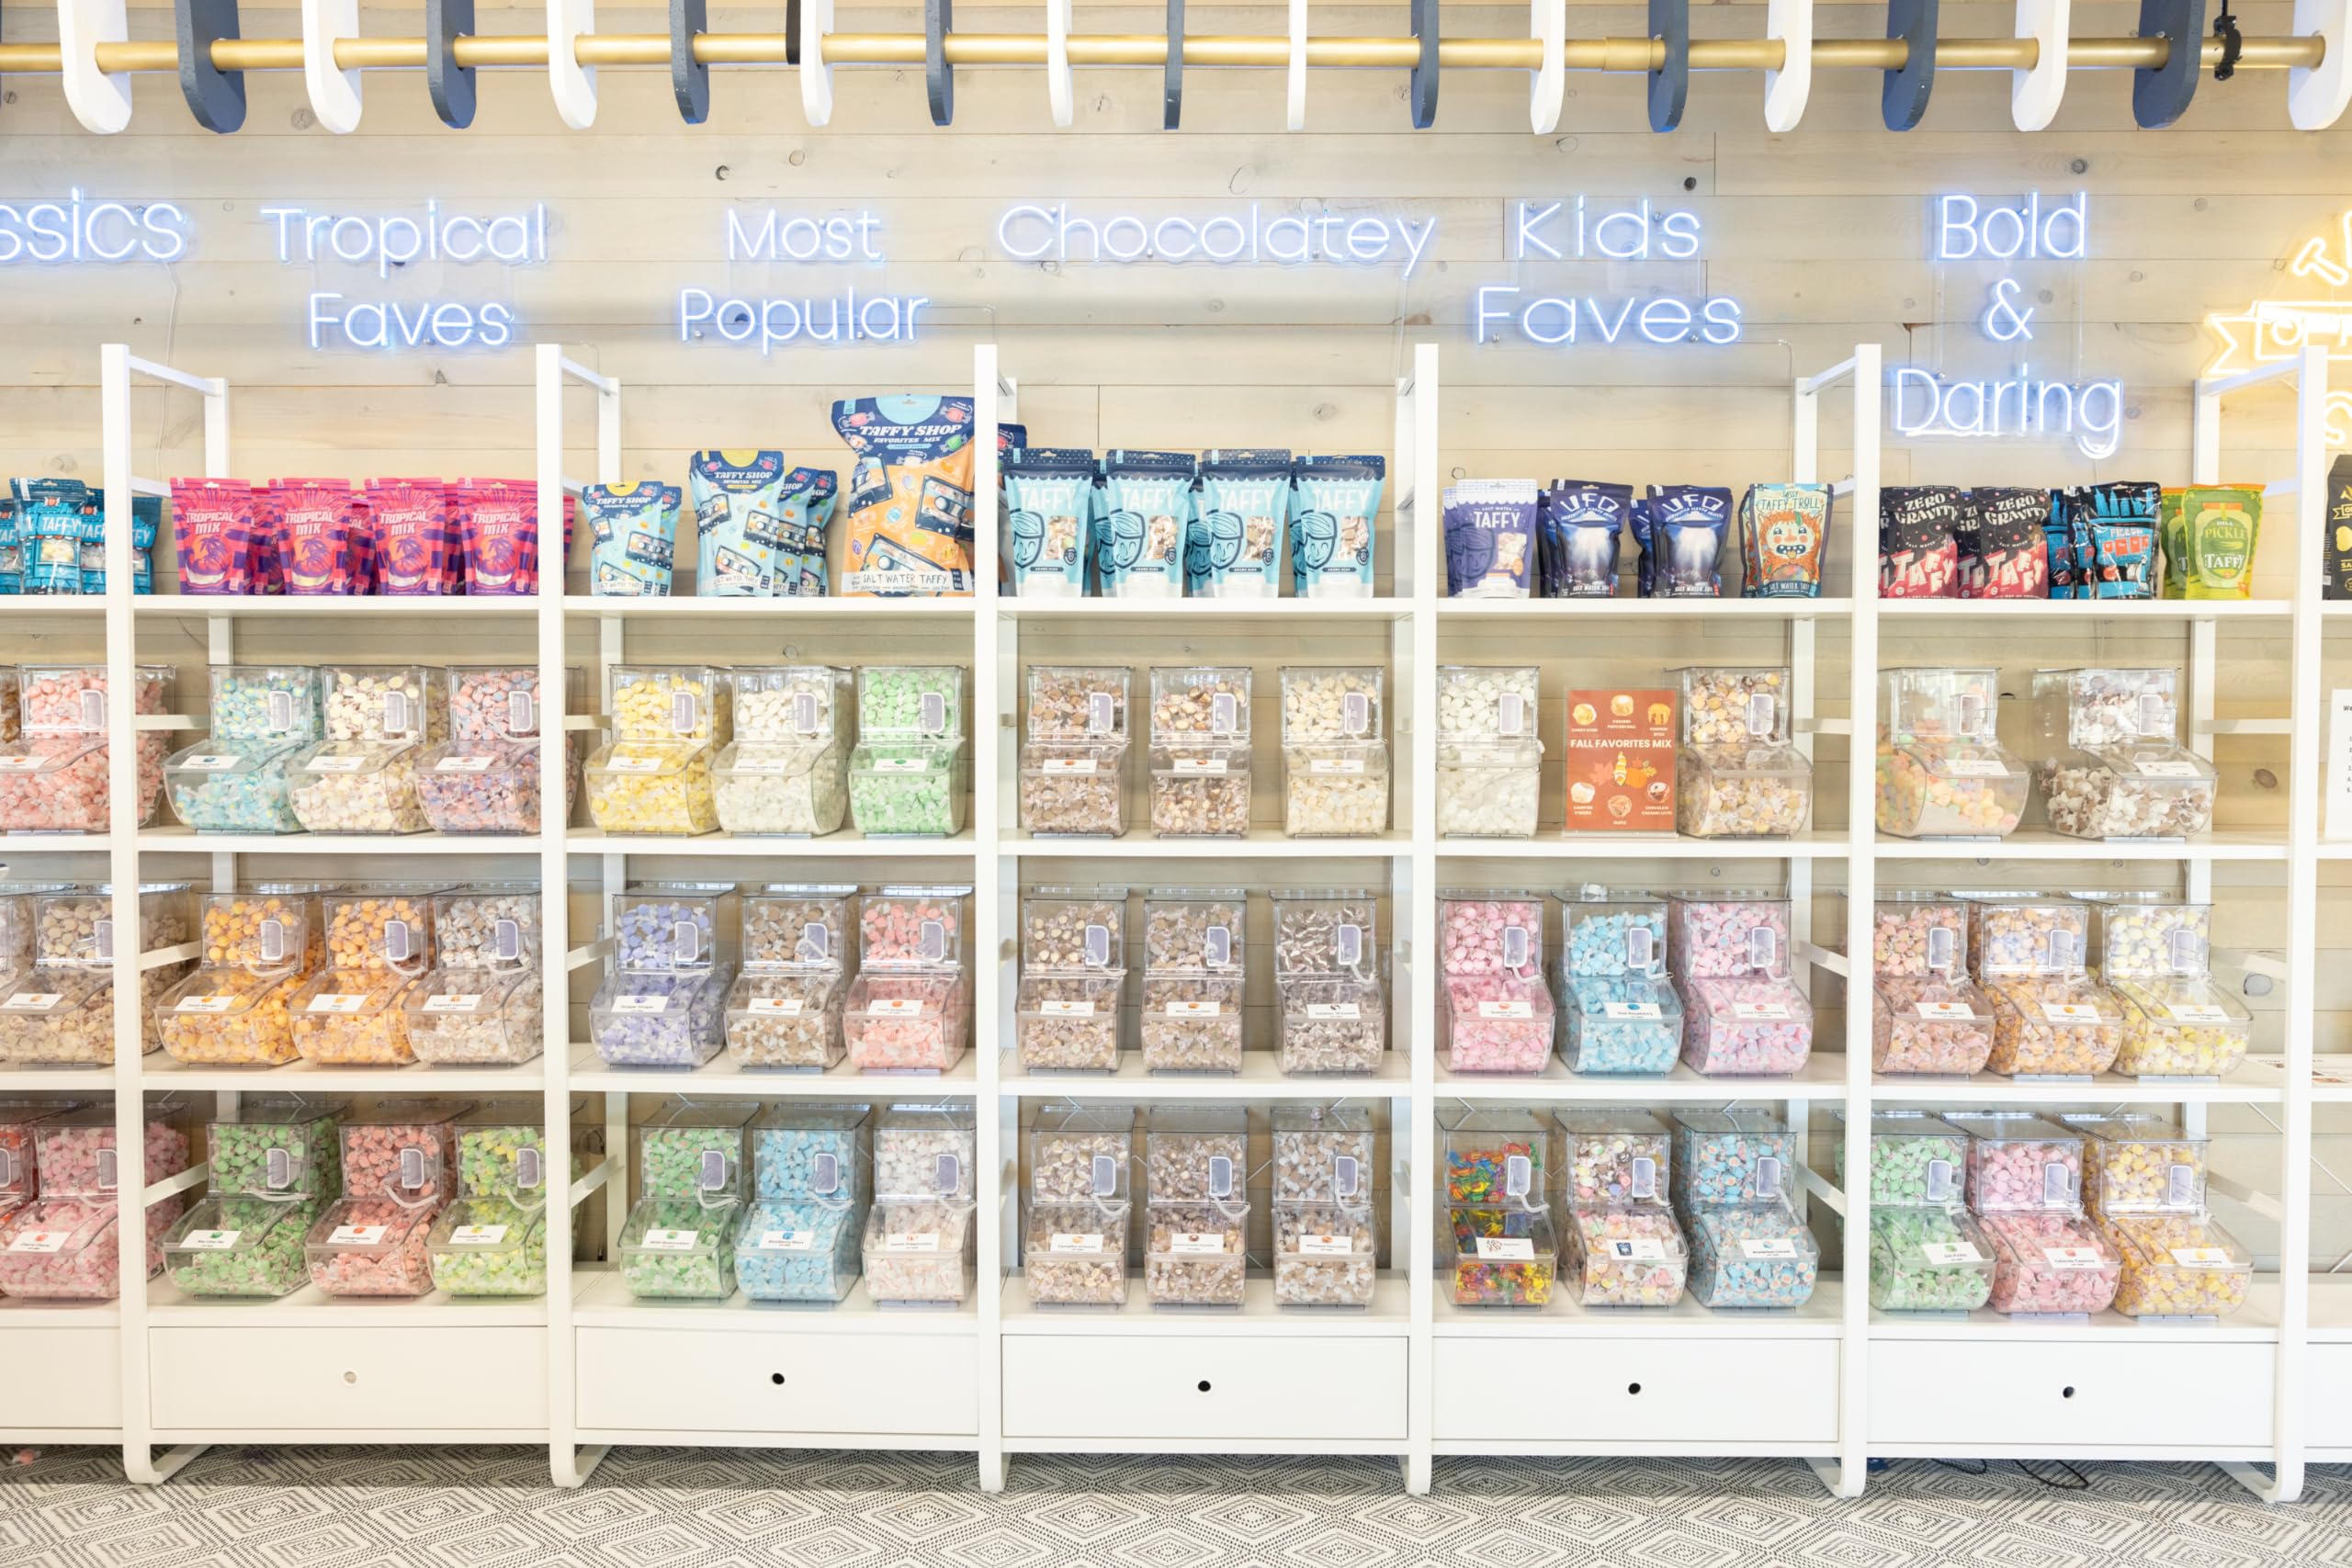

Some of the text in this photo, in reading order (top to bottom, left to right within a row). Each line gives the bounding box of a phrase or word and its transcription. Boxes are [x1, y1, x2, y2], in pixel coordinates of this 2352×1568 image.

[728, 209, 882, 261] Most
[1517, 195, 1702, 259] Kids
[1940, 191, 2086, 259] Bold
[261, 199, 546, 277] Tropical
[999, 202, 1436, 277] Chocolatey
[1477, 286, 1741, 344] Faves
[1985, 278, 2034, 342] &
[310, 293, 512, 348] Faves
[681, 287, 929, 355] Popular
[1895, 363, 2122, 458] Daring
[860, 424, 962, 435] TAFFY SHOP
[596, 496, 651, 505] TAFFY SHOP
[1019, 487, 1076, 510] TAFFY
[1121, 488, 1174, 510] TAFFY
[1217, 489, 1274, 511] TAFFY
[1313, 489, 1370, 511] TAFFY
[1560, 492, 1620, 513] UFO
[1661, 493, 1724, 513] UFO
[1761, 498, 1820, 510] TAFFY TROLL
[1905, 492, 1945, 511] ZERO
[1996, 494, 2035, 511] ZERO
[42, 516, 79, 532] TAFFY
[187, 512, 234, 524] TROPICAL
[286, 512, 334, 524] TROPICAL
[379, 511, 429, 525] TROPICAL
[472, 511, 522, 525] TROPICAL
[1474, 511, 1521, 528] TAFFY
[1894, 505, 1958, 525] GRAVITY
[1984, 507, 2048, 525] GRAVITY
[196, 522, 220, 535] MIX
[296, 523, 322, 535] MIX
[391, 523, 415, 536] MIX
[483, 523, 509, 536] MIX
[2205, 553, 2245, 570] TAFFY
[1891, 552, 1954, 592] TAFFY
[1984, 552, 2044, 592] TAFFY
[1570, 739, 1672, 749] FALL FAVORITES MIX
